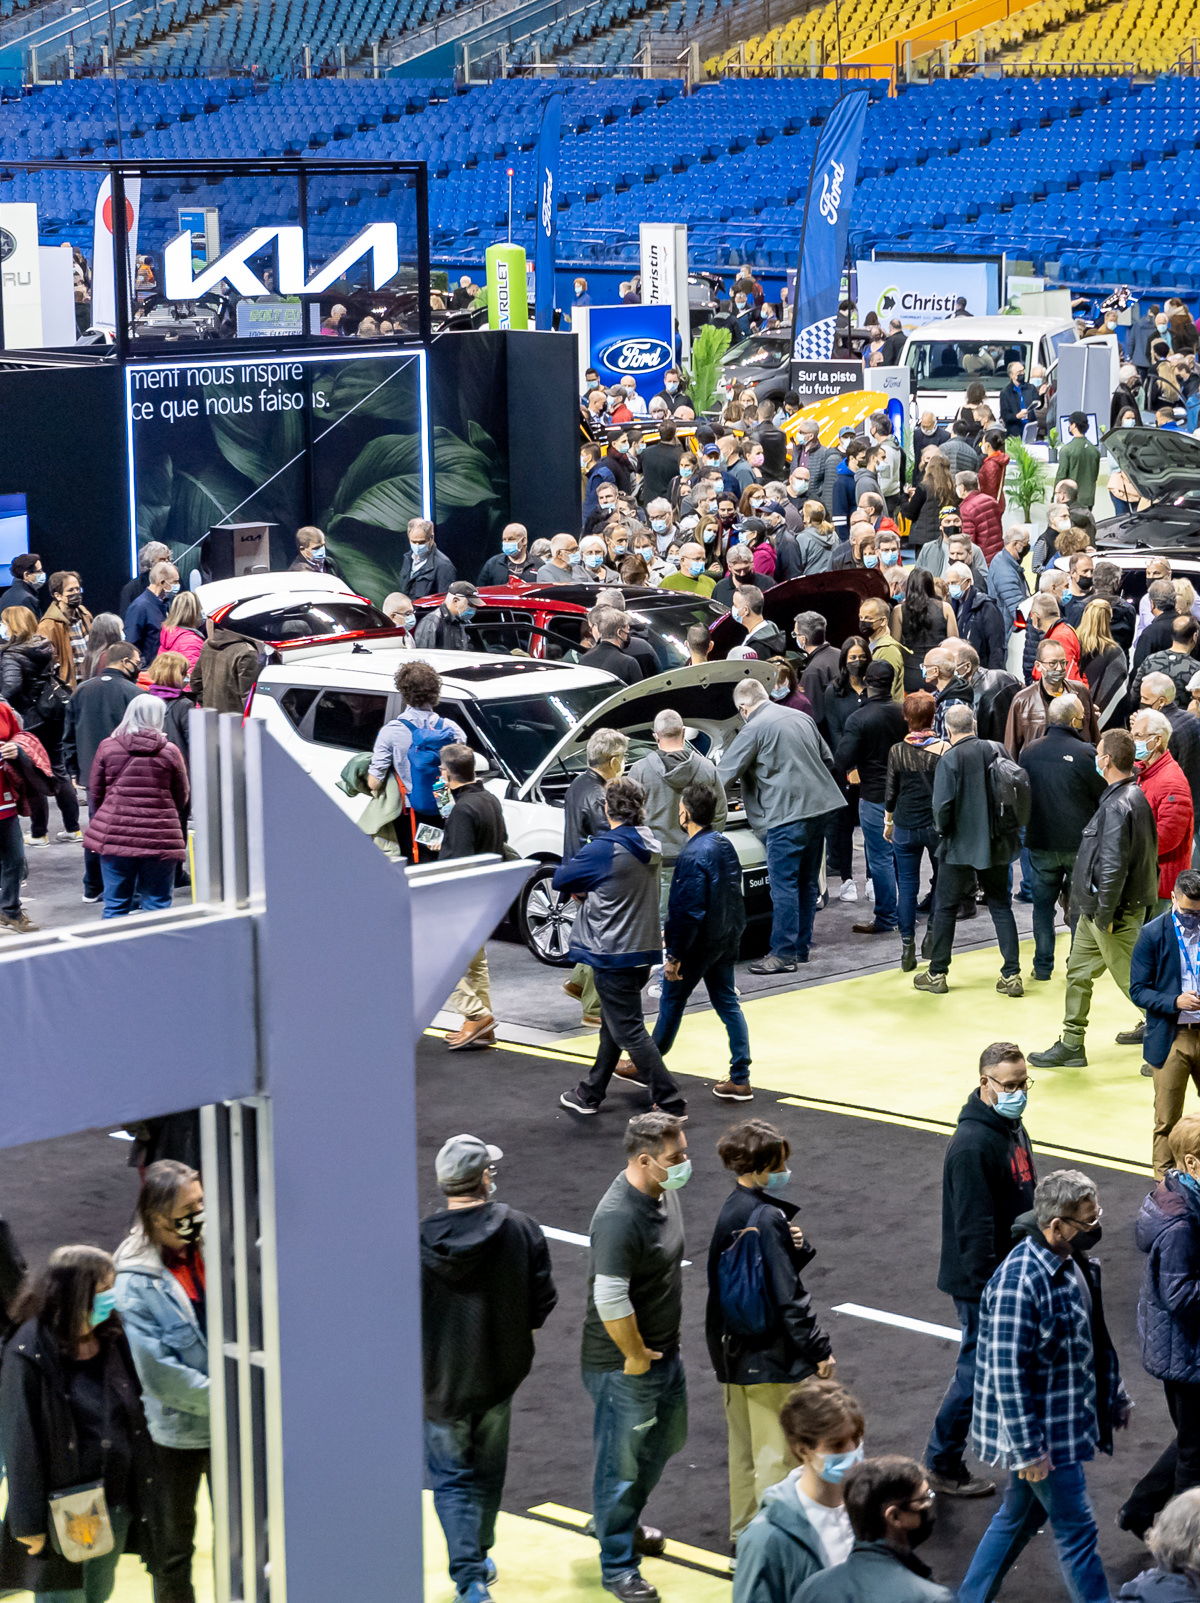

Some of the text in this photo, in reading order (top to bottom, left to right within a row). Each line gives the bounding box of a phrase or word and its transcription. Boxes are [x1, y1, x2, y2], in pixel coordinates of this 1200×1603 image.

[819, 159, 845, 225] Ford
[541, 167, 553, 237] Ford
[164, 222, 399, 300] KIA
[249, 309, 279, 322] BOLT
[618, 343, 661, 369] Ford
[187, 367, 234, 387] nous
[241, 363, 303, 387] inspire
[798, 370, 857, 383] Sur la piste
[883, 376, 902, 389] Ford
[798, 383, 841, 395] du futur
[131, 400, 154, 420] ce
[160, 398, 199, 424] que
[206, 395, 253, 415] nous
[240, 534, 261, 542] KIA
[749, 876, 764, 888] Soul
